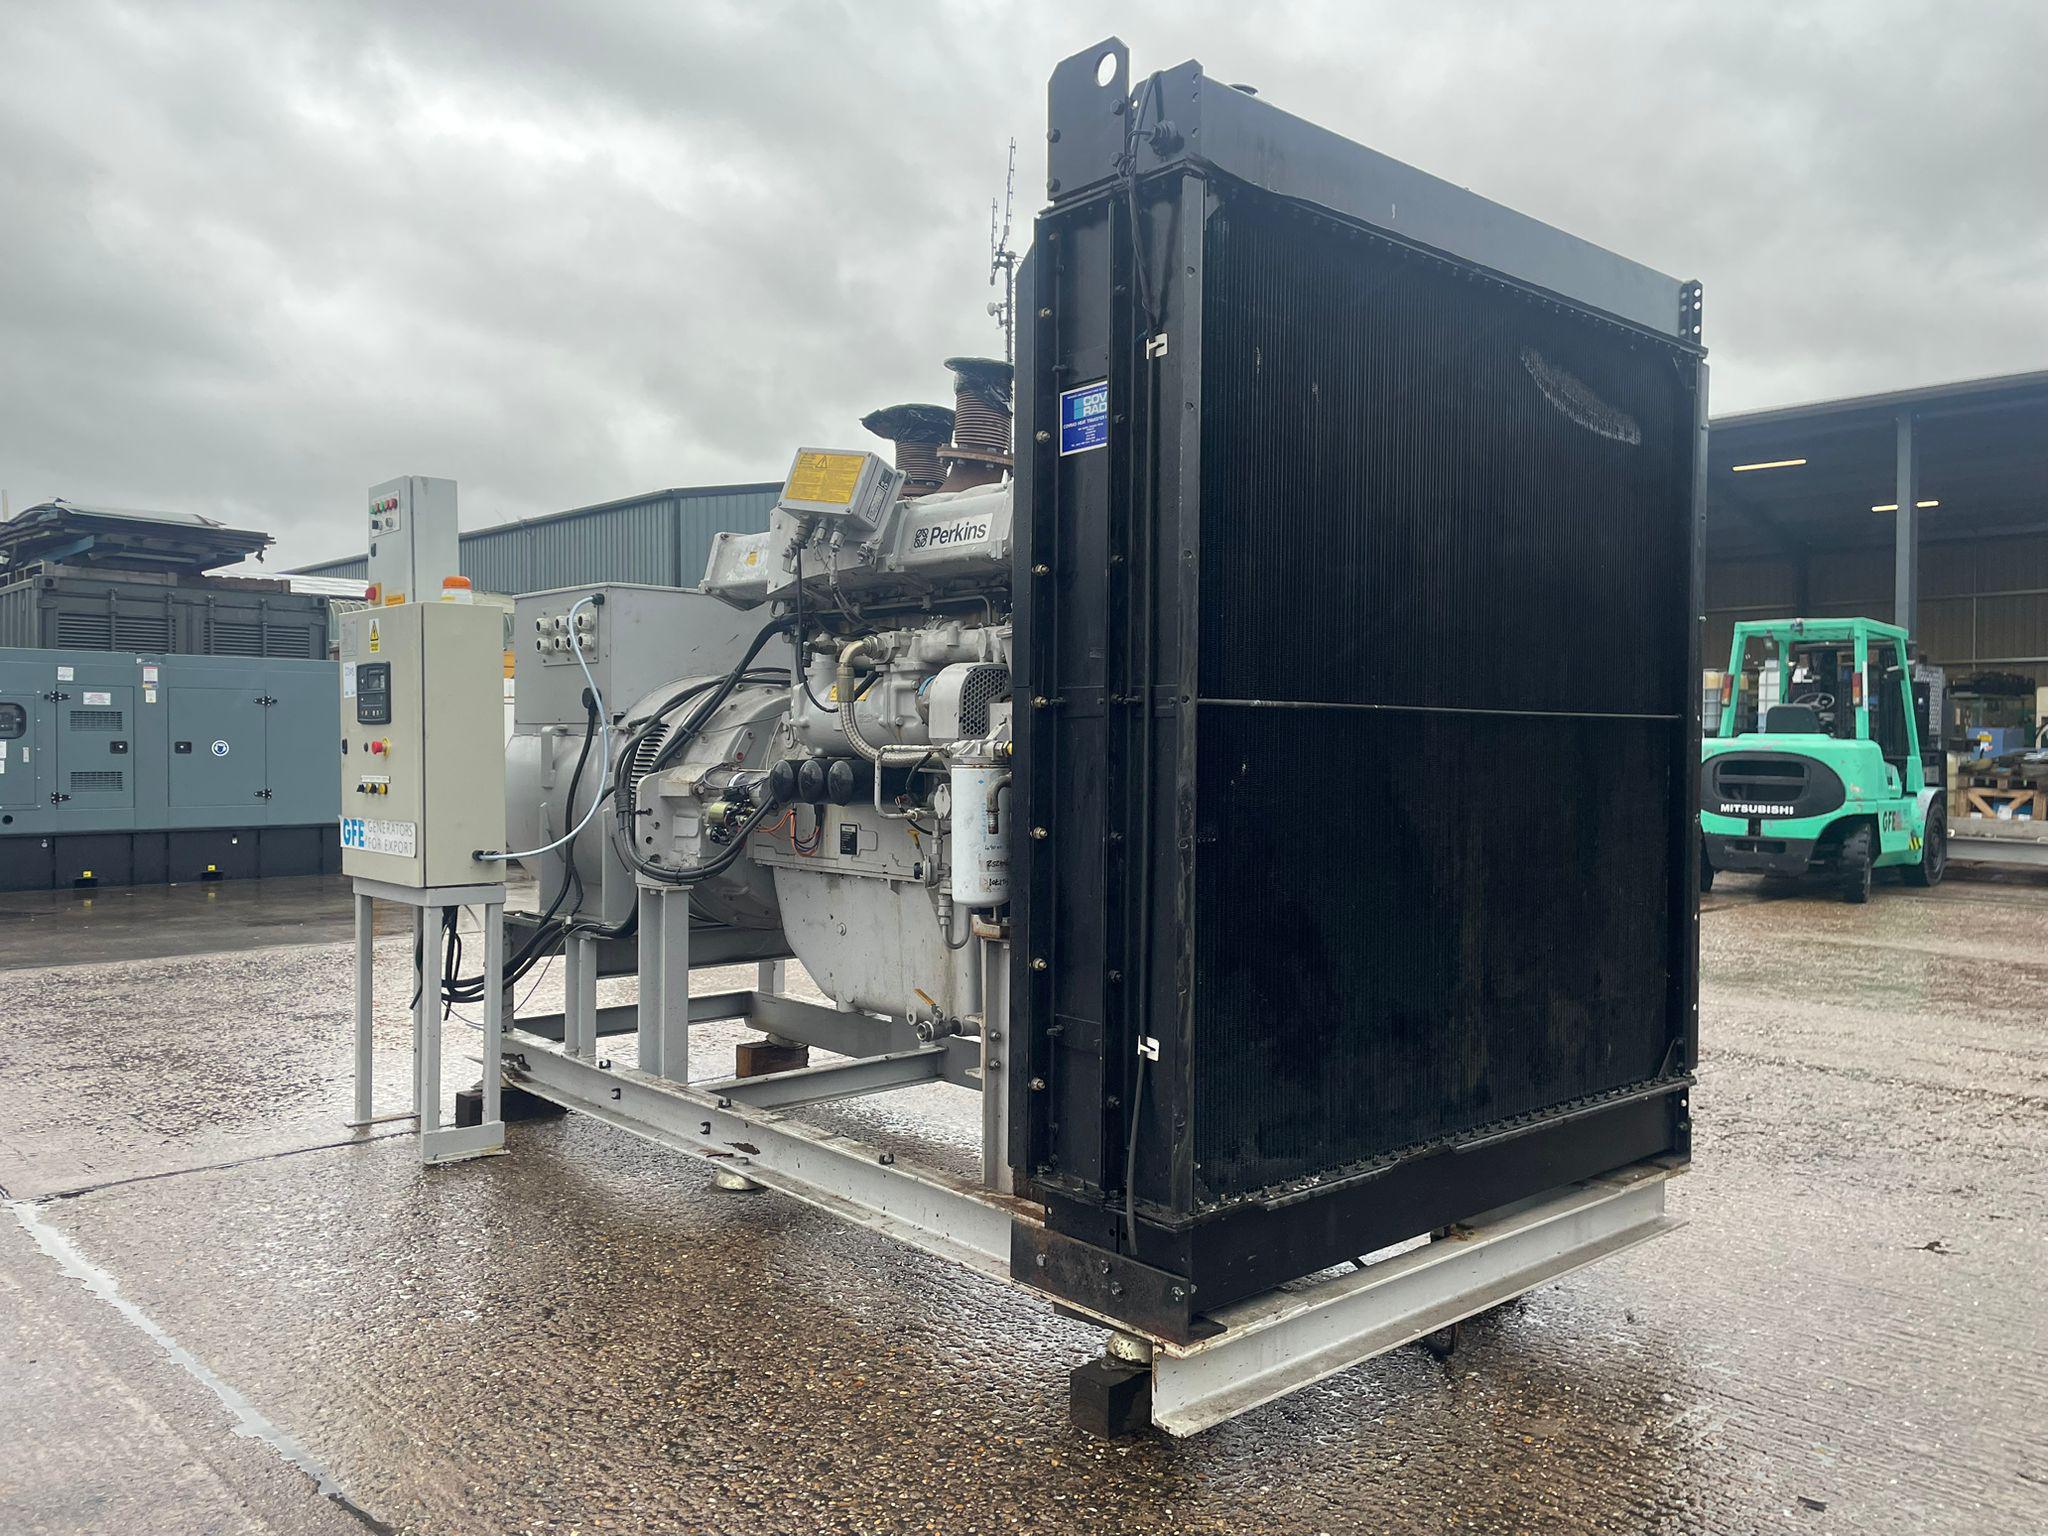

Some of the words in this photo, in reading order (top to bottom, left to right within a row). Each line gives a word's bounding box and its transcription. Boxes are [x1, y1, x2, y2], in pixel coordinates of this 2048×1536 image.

[1083, 390, 1107, 406] COV
[1083, 402, 1107, 417] RAD
[929, 521, 987, 546] Perkins
[1720, 803, 1794, 815] MITSUBISHI
[368, 820, 413, 837] GENERATORS
[1883, 811, 1896, 832] GFE
[343, 818, 365, 847] GFE
[368, 836, 381, 850] FOR
[384, 838, 413, 854] EXPORT
